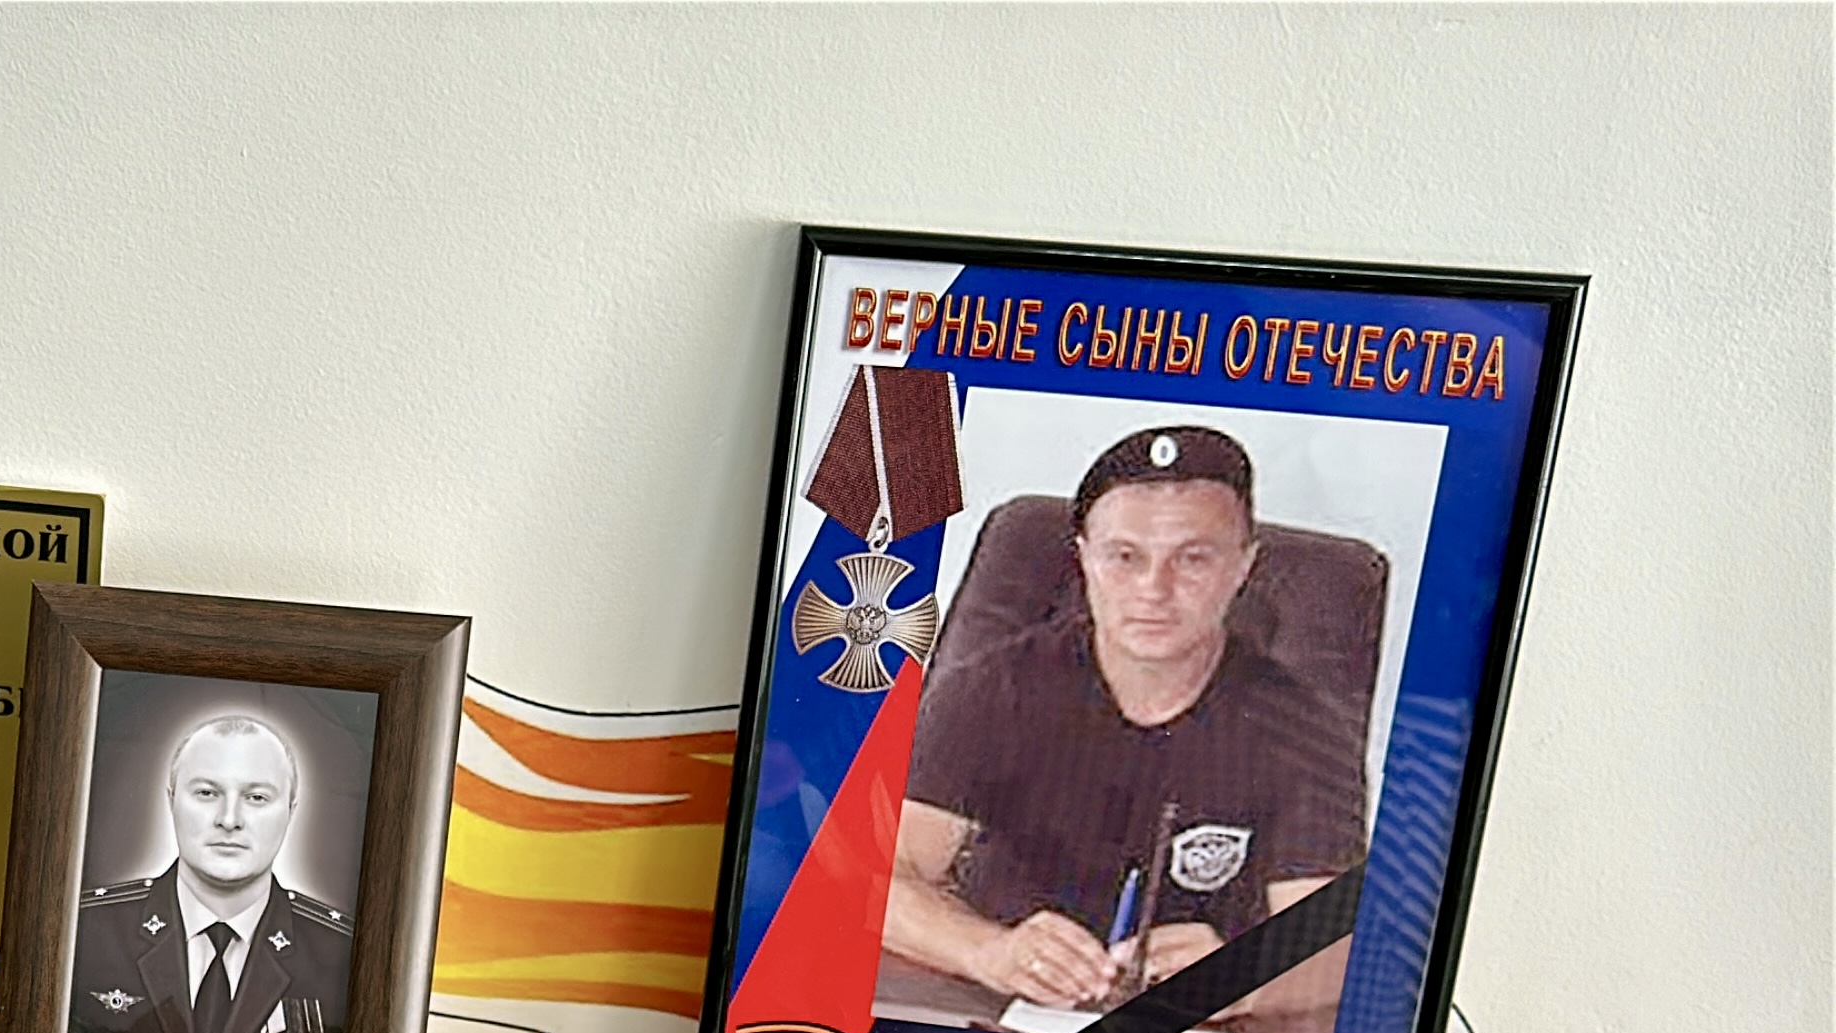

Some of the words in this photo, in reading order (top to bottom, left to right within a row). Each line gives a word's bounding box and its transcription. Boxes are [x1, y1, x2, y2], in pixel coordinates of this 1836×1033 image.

[846, 287, 1044, 362] ВЕРНЫЕ
[1058, 301, 1209, 375] СЫНЫ
[1224, 314, 1505, 400] ОТЕЧЕСТВА
